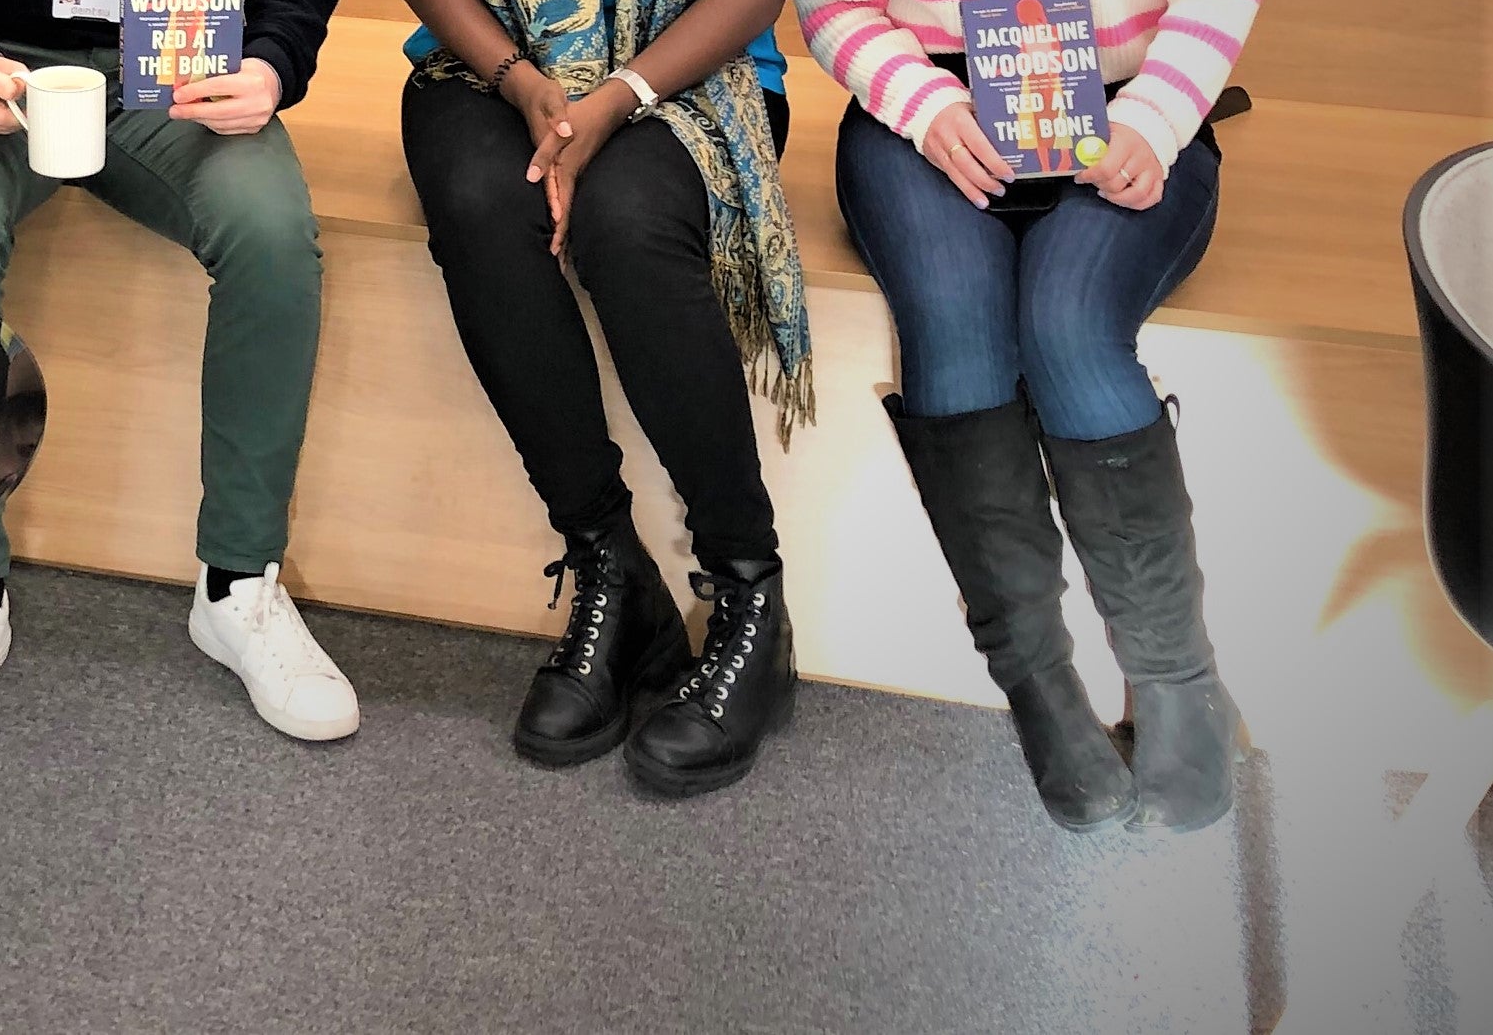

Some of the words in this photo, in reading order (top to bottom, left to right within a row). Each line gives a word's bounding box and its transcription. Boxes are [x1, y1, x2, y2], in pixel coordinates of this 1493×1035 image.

[151, 30, 187, 50] RED
[192, 29, 216, 49] AT
[976, 20, 1090, 49] JACQUELINE
[137, 56, 173, 76] THE
[178, 54, 229, 75] BONE
[973, 46, 1097, 80] WOODSON
[1005, 92, 1044, 115] RED
[1051, 90, 1075, 111] AT
[993, 121, 1034, 142] THE
[1039, 115, 1096, 139] BONE
